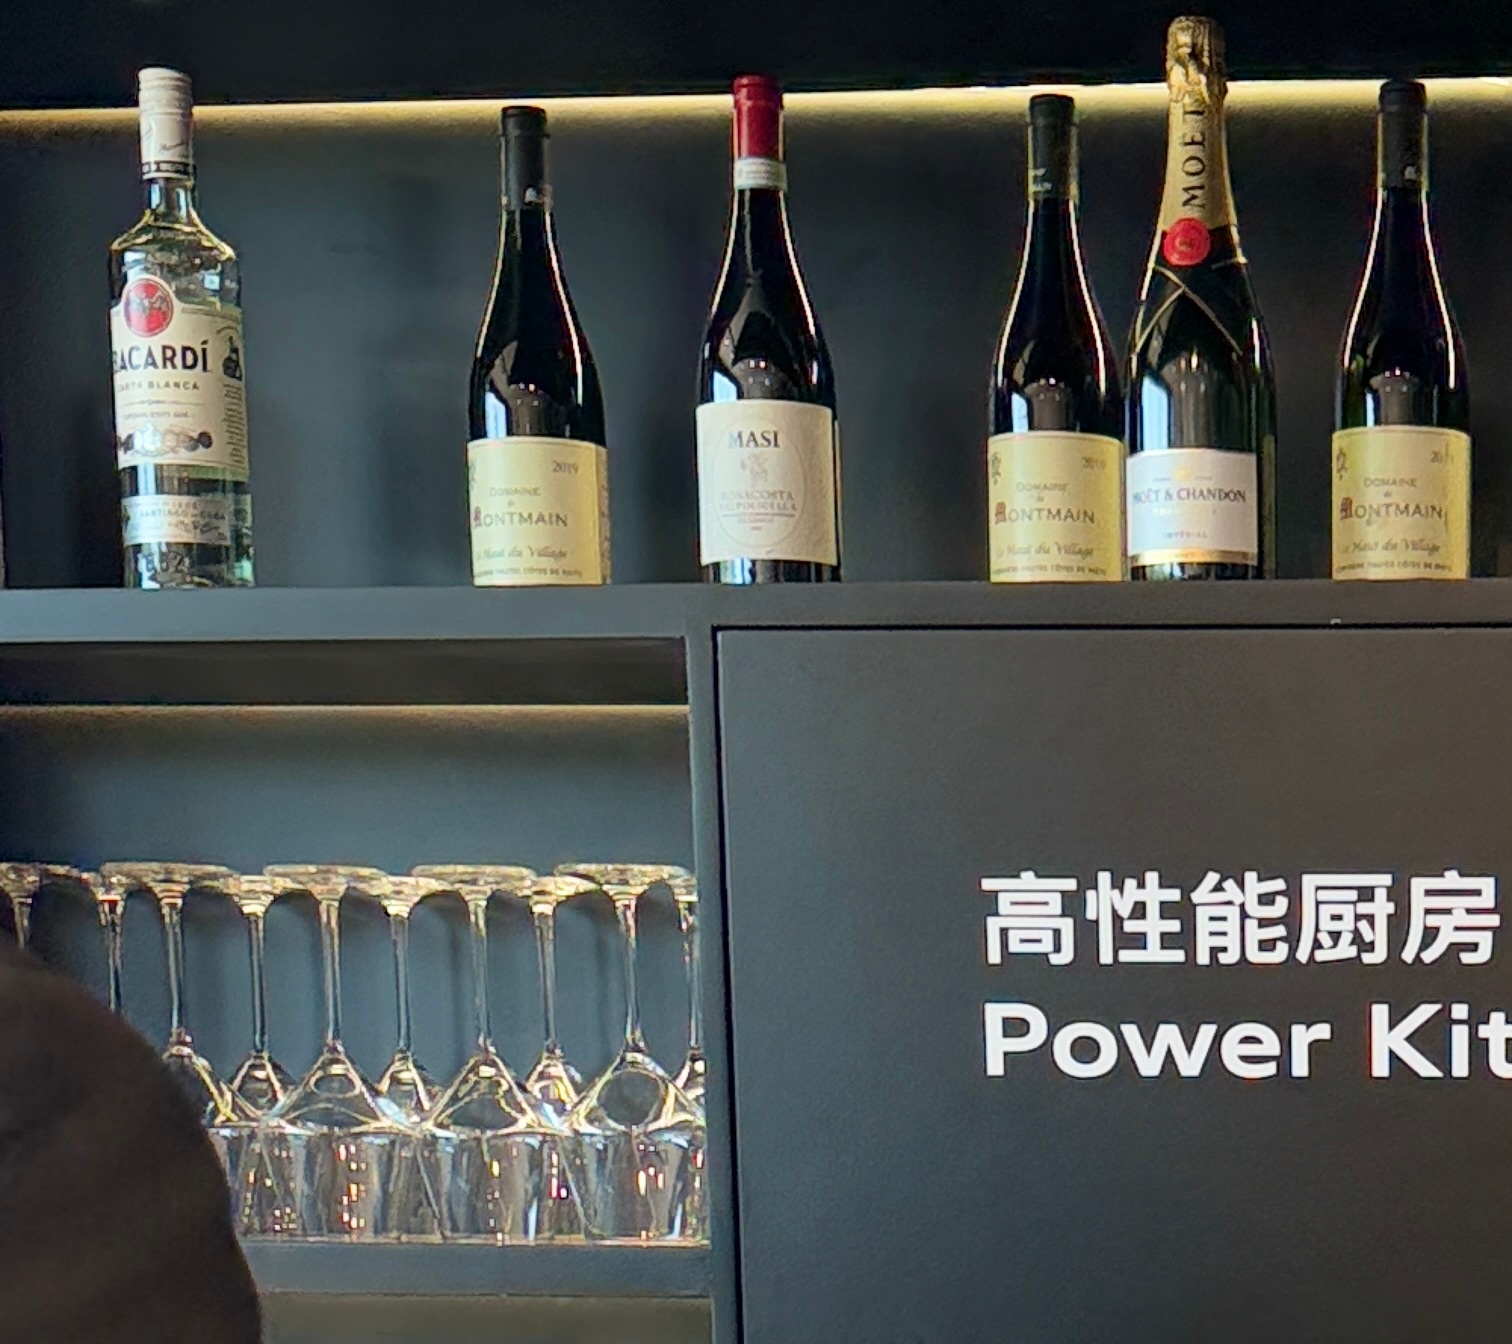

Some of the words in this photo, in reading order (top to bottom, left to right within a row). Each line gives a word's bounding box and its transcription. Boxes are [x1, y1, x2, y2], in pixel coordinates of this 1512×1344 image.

[728, 430, 781, 448] MASI
[1176, 487, 1247, 503] CHANDON
[979, 869, 1501, 967] 高性能厨房
[983, 1002, 1331, 1078] Power
